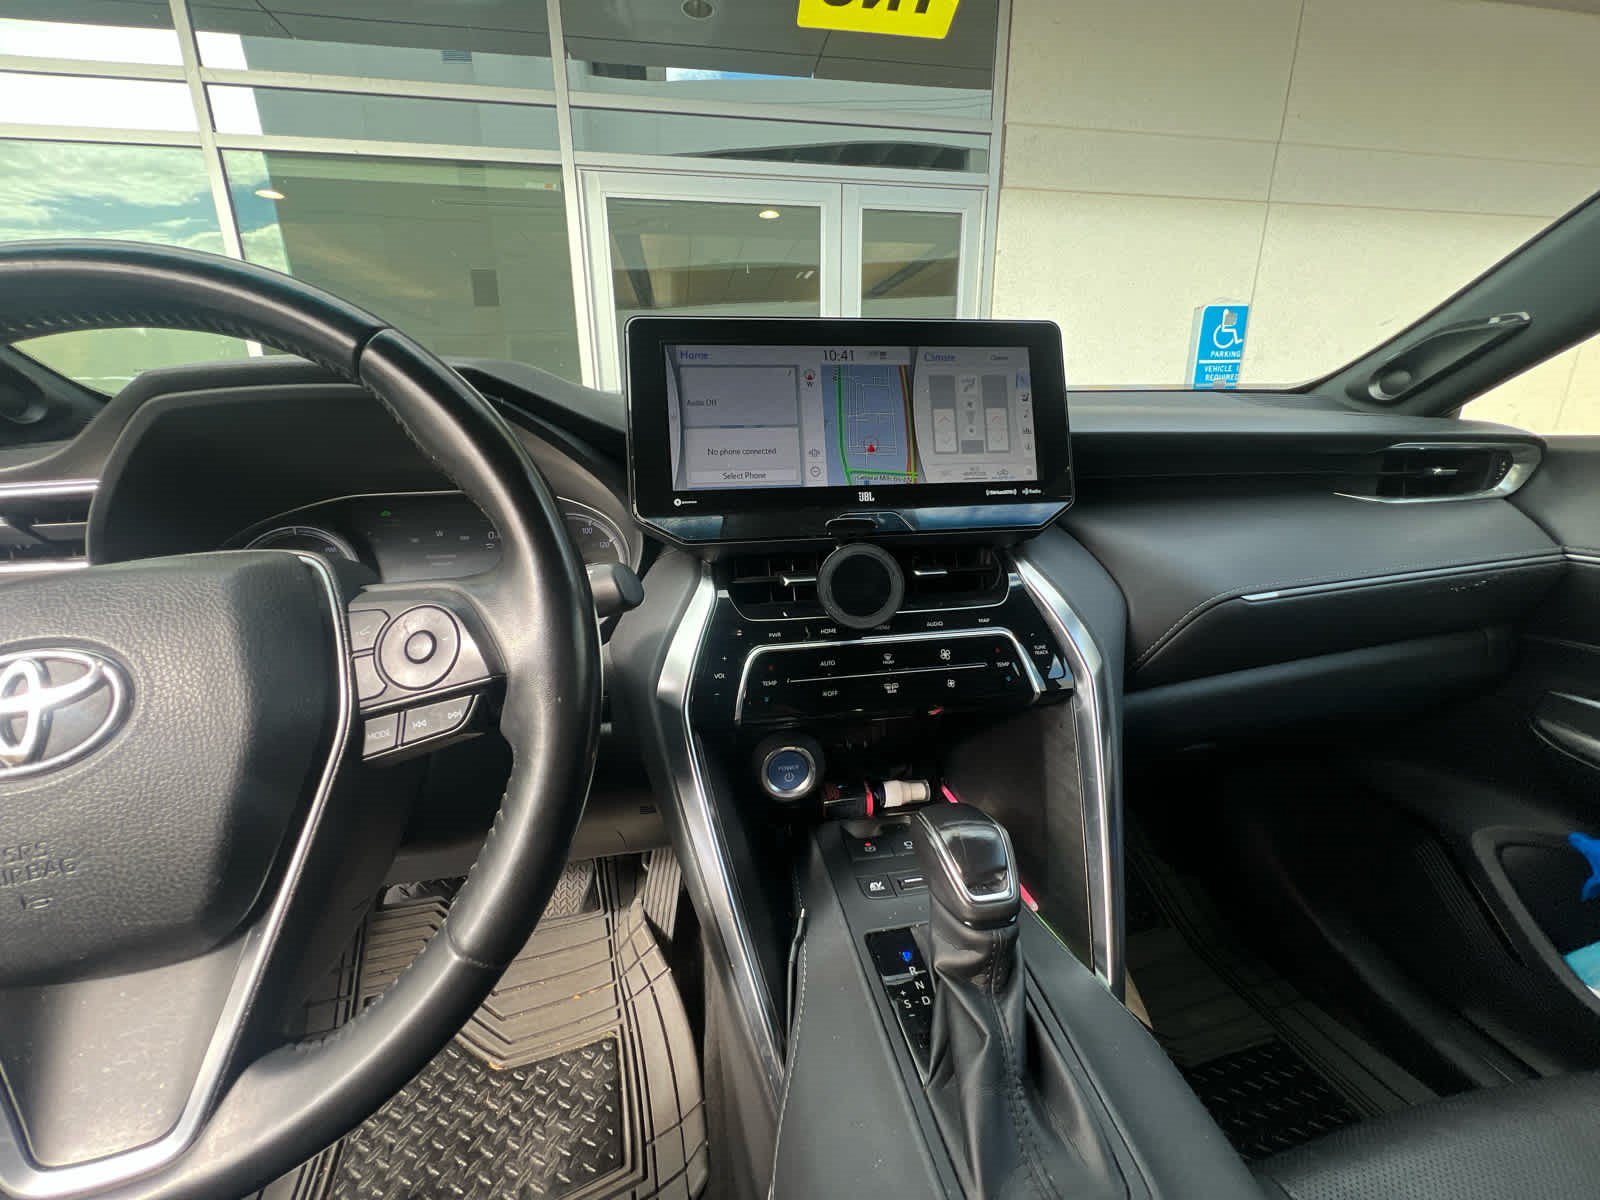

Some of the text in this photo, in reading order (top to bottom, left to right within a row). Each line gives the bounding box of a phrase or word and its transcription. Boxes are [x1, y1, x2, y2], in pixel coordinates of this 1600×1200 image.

[680, 351, 710, 360] Home
[823, 350, 855, 361] 10:41
[1210, 350, 1241, 358] PARKING
[1204, 365, 1233, 373] VEHICLE
[707, 447, 777, 458] No phone connected
[721, 472, 766, 480] Select Phone
[858, 491, 875, 502] JBL
[582, 527, 593, 535] 100
[820, 627, 837, 635] HOME
[820, 659, 836, 667] AUTO
[908, 965, 919, 976] R
[914, 980, 926, 990] N
[903, 999, 913, 1009] S
[920, 995, 931, 1006] D
